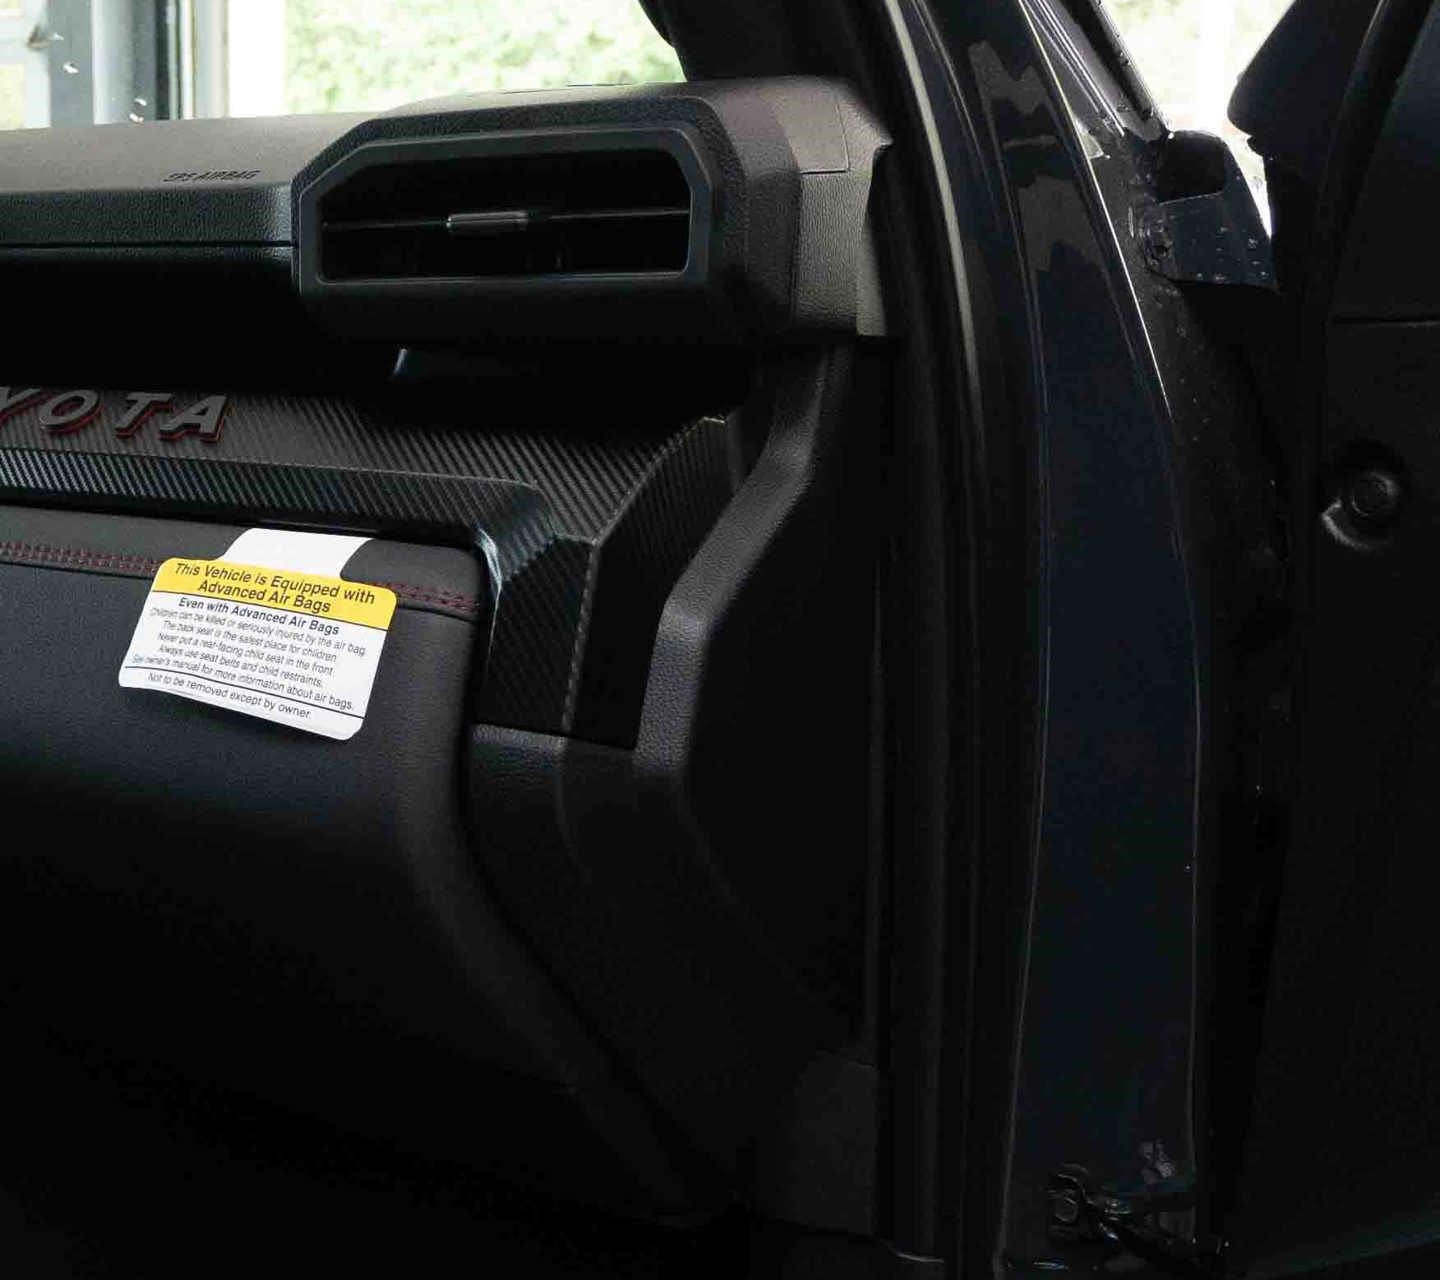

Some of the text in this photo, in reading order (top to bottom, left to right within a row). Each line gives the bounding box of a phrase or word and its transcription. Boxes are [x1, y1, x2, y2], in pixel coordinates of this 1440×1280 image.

[174, 562, 377, 604] This Vehicle is Equipped with
[198, 579, 333, 616] Advanced Air Bags
[178, 597, 341, 637] Even with Advanced Air Bags
[205, 614, 226, 625] killed
[236, 620, 274, 636] seriously
[274, 628, 304, 642] injured
[303, 634, 317, 645] by
[317, 637, 333, 647] the
[333, 641, 346, 650] air
[199, 638, 244, 657] rear-facing
[243, 648, 265, 660] child
[264, 652, 285, 664] seat
[295, 659, 311, 670] the
[222, 630, 238, 641] the
[263, 639, 288, 652] place
[288, 644, 301, 654] for
[199, 651, 219, 663] seat
[218, 656, 241, 668] belts
[240, 661, 258, 672] and
[257, 665, 279, 677] child
[172, 677, 185, 687] be
[185, 679, 229, 698] removed
[229, 689, 262, 706] except
[261, 698, 276, 711] by
[200, 664, 214, 674] for
[214, 668, 237, 681] more
[236, 673, 285, 692] information
[286, 685, 313, 699] about
[313, 692, 327, 703] air
